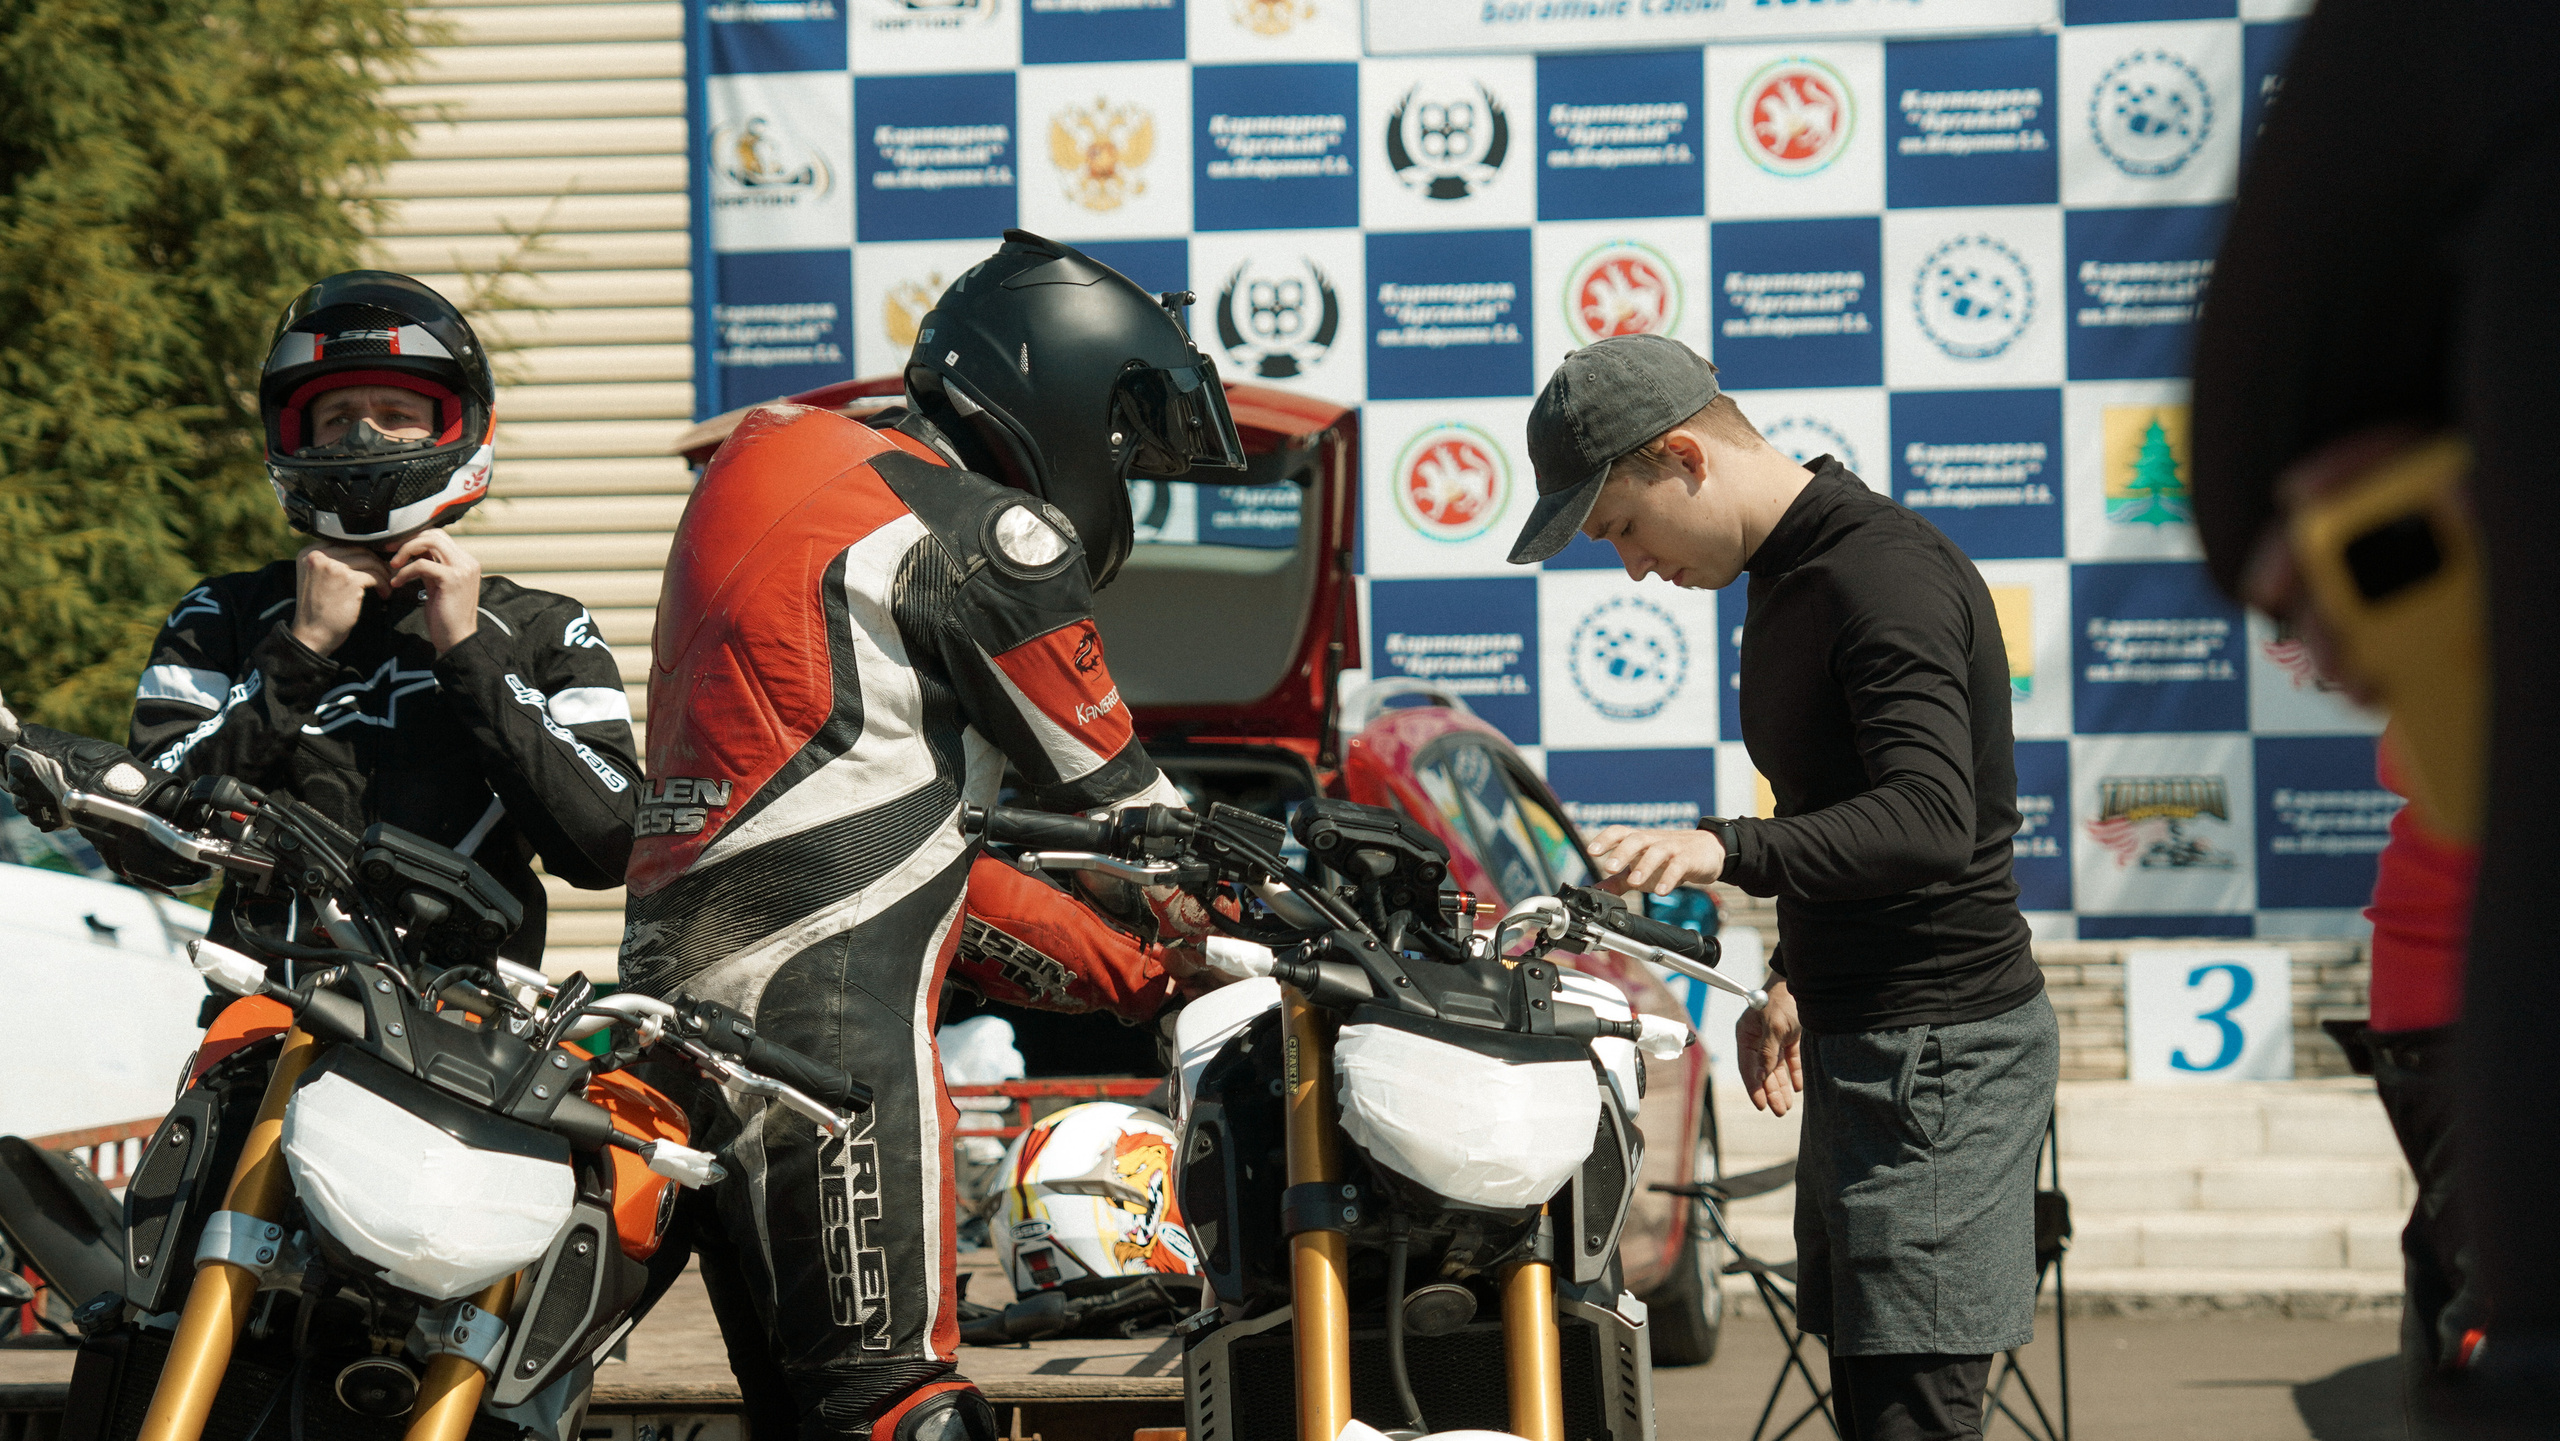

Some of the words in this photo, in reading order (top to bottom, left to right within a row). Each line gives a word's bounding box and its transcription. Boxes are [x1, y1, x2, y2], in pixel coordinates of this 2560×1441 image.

[315, 329, 397, 346] LS2
[642, 777, 734, 809] LEN
[635, 807, 708, 836] ESS
[2170, 963, 2255, 1073] 3
[1288, 1038, 1299, 1093] CHAKIN
